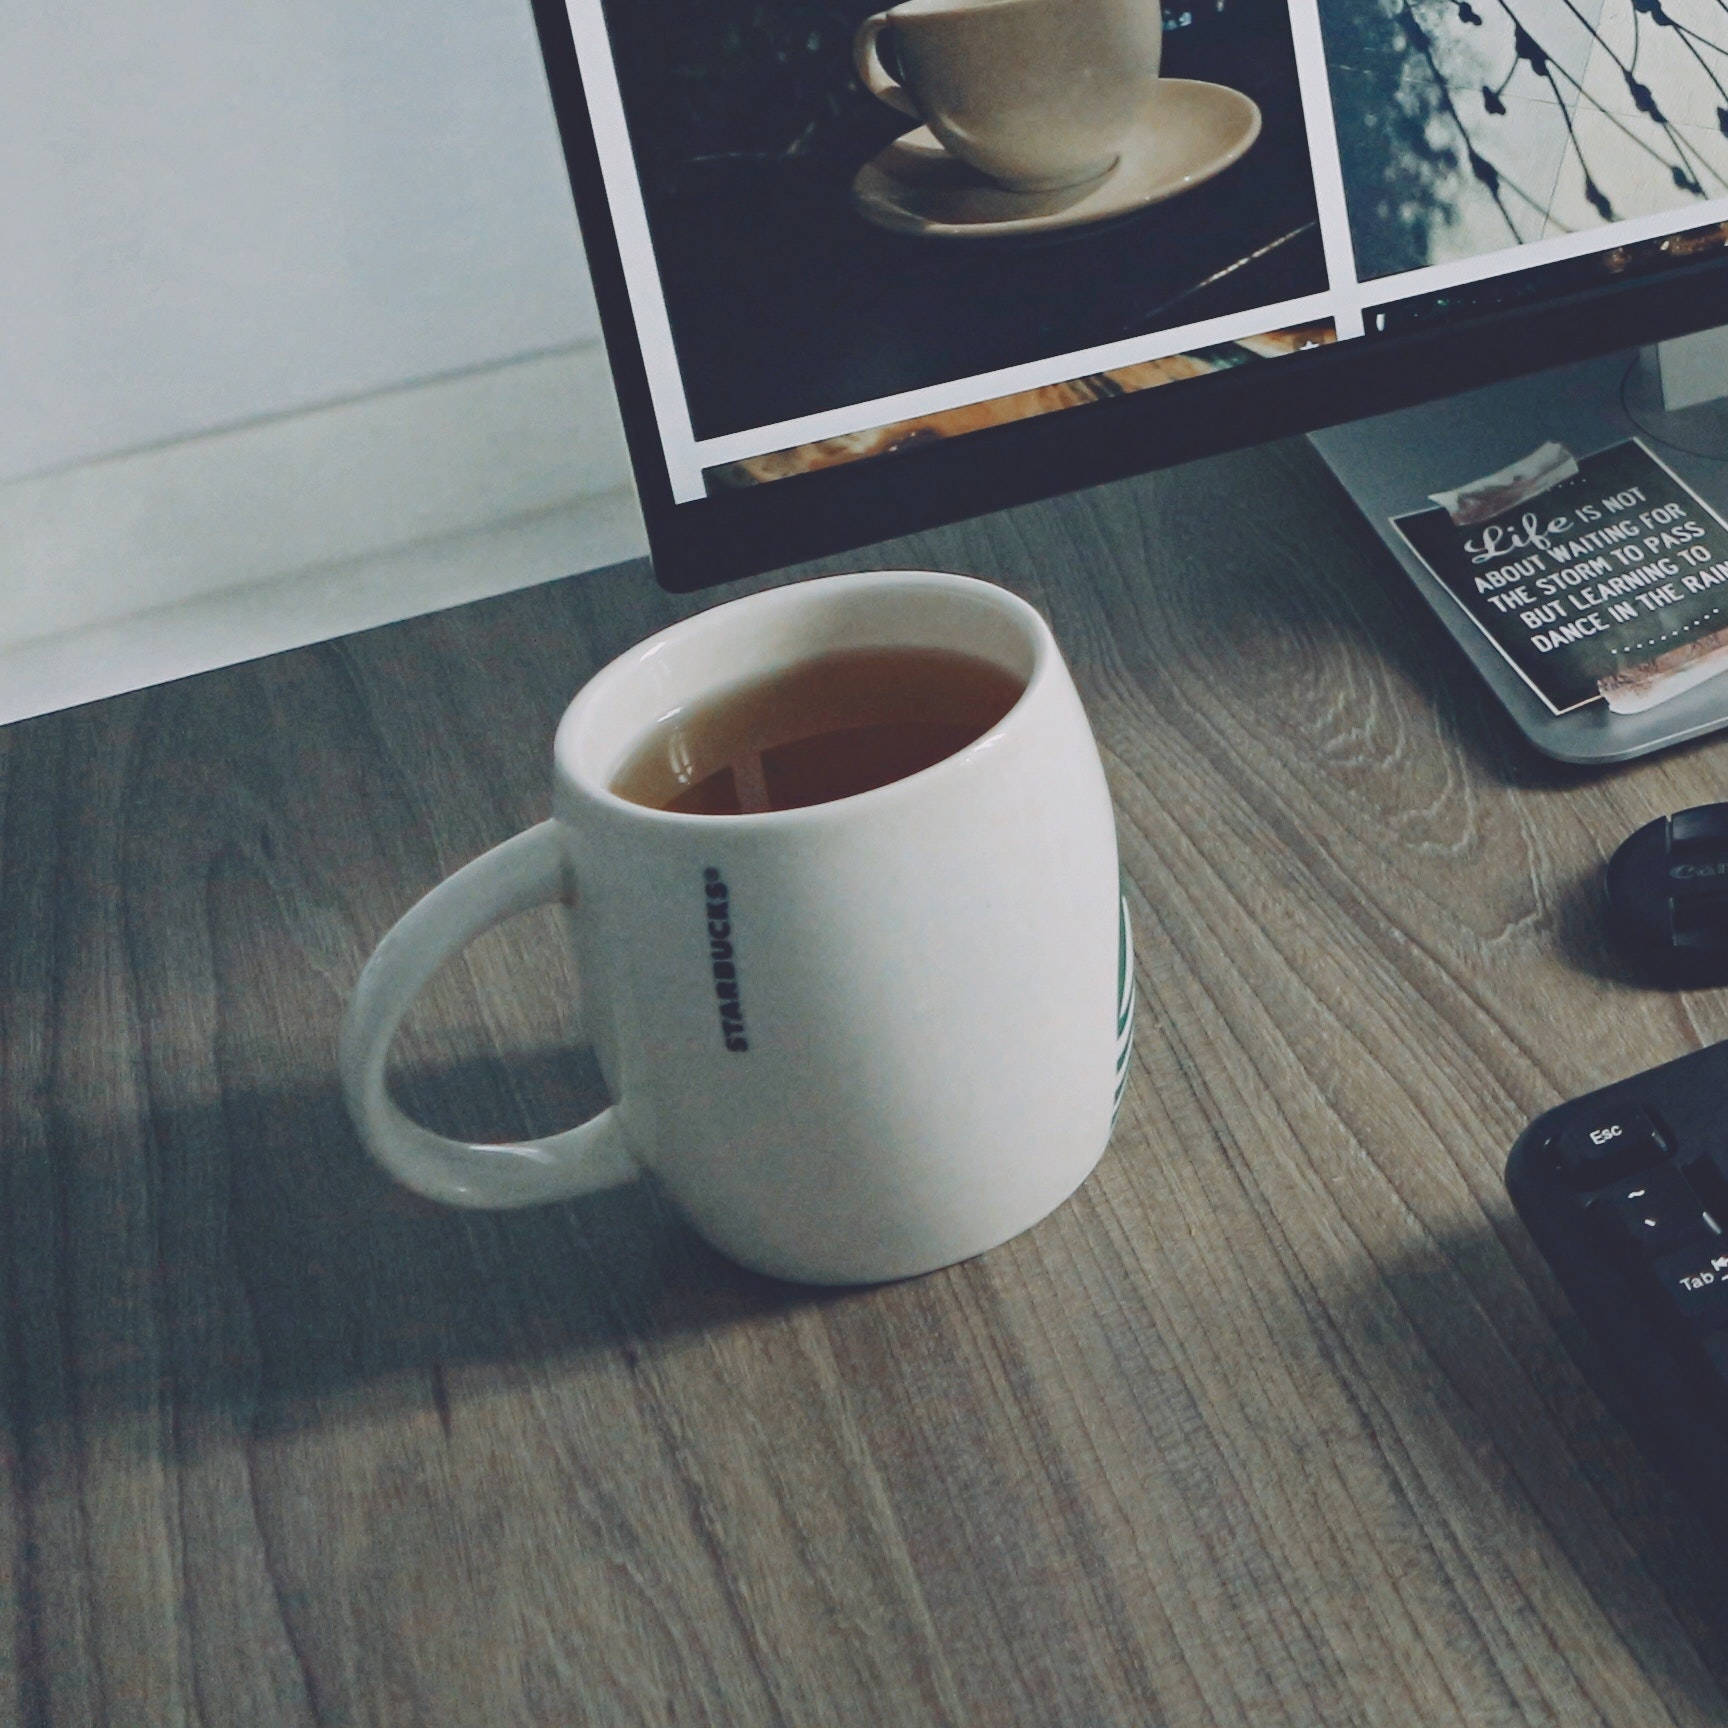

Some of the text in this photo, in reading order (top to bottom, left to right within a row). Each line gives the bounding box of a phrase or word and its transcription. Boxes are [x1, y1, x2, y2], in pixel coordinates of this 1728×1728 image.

[1464, 486, 1647, 564] Life IS NOT
[1474, 502, 1687, 595] ABOUT WAITING FOR
[1488, 521, 1707, 615] THE STORM TO PASS
[1520, 544, 1712, 631] BUT LEARNING TO
[1530, 617, 1610, 655] DANCE
[1611, 602, 1637, 625] IN
[1637, 586, 1684, 613] THE
[704, 882, 749, 1053] STARBUCKS
[1589, 1125, 1623, 1145] Esc
[1679, 1272, 1715, 1291] Tab
